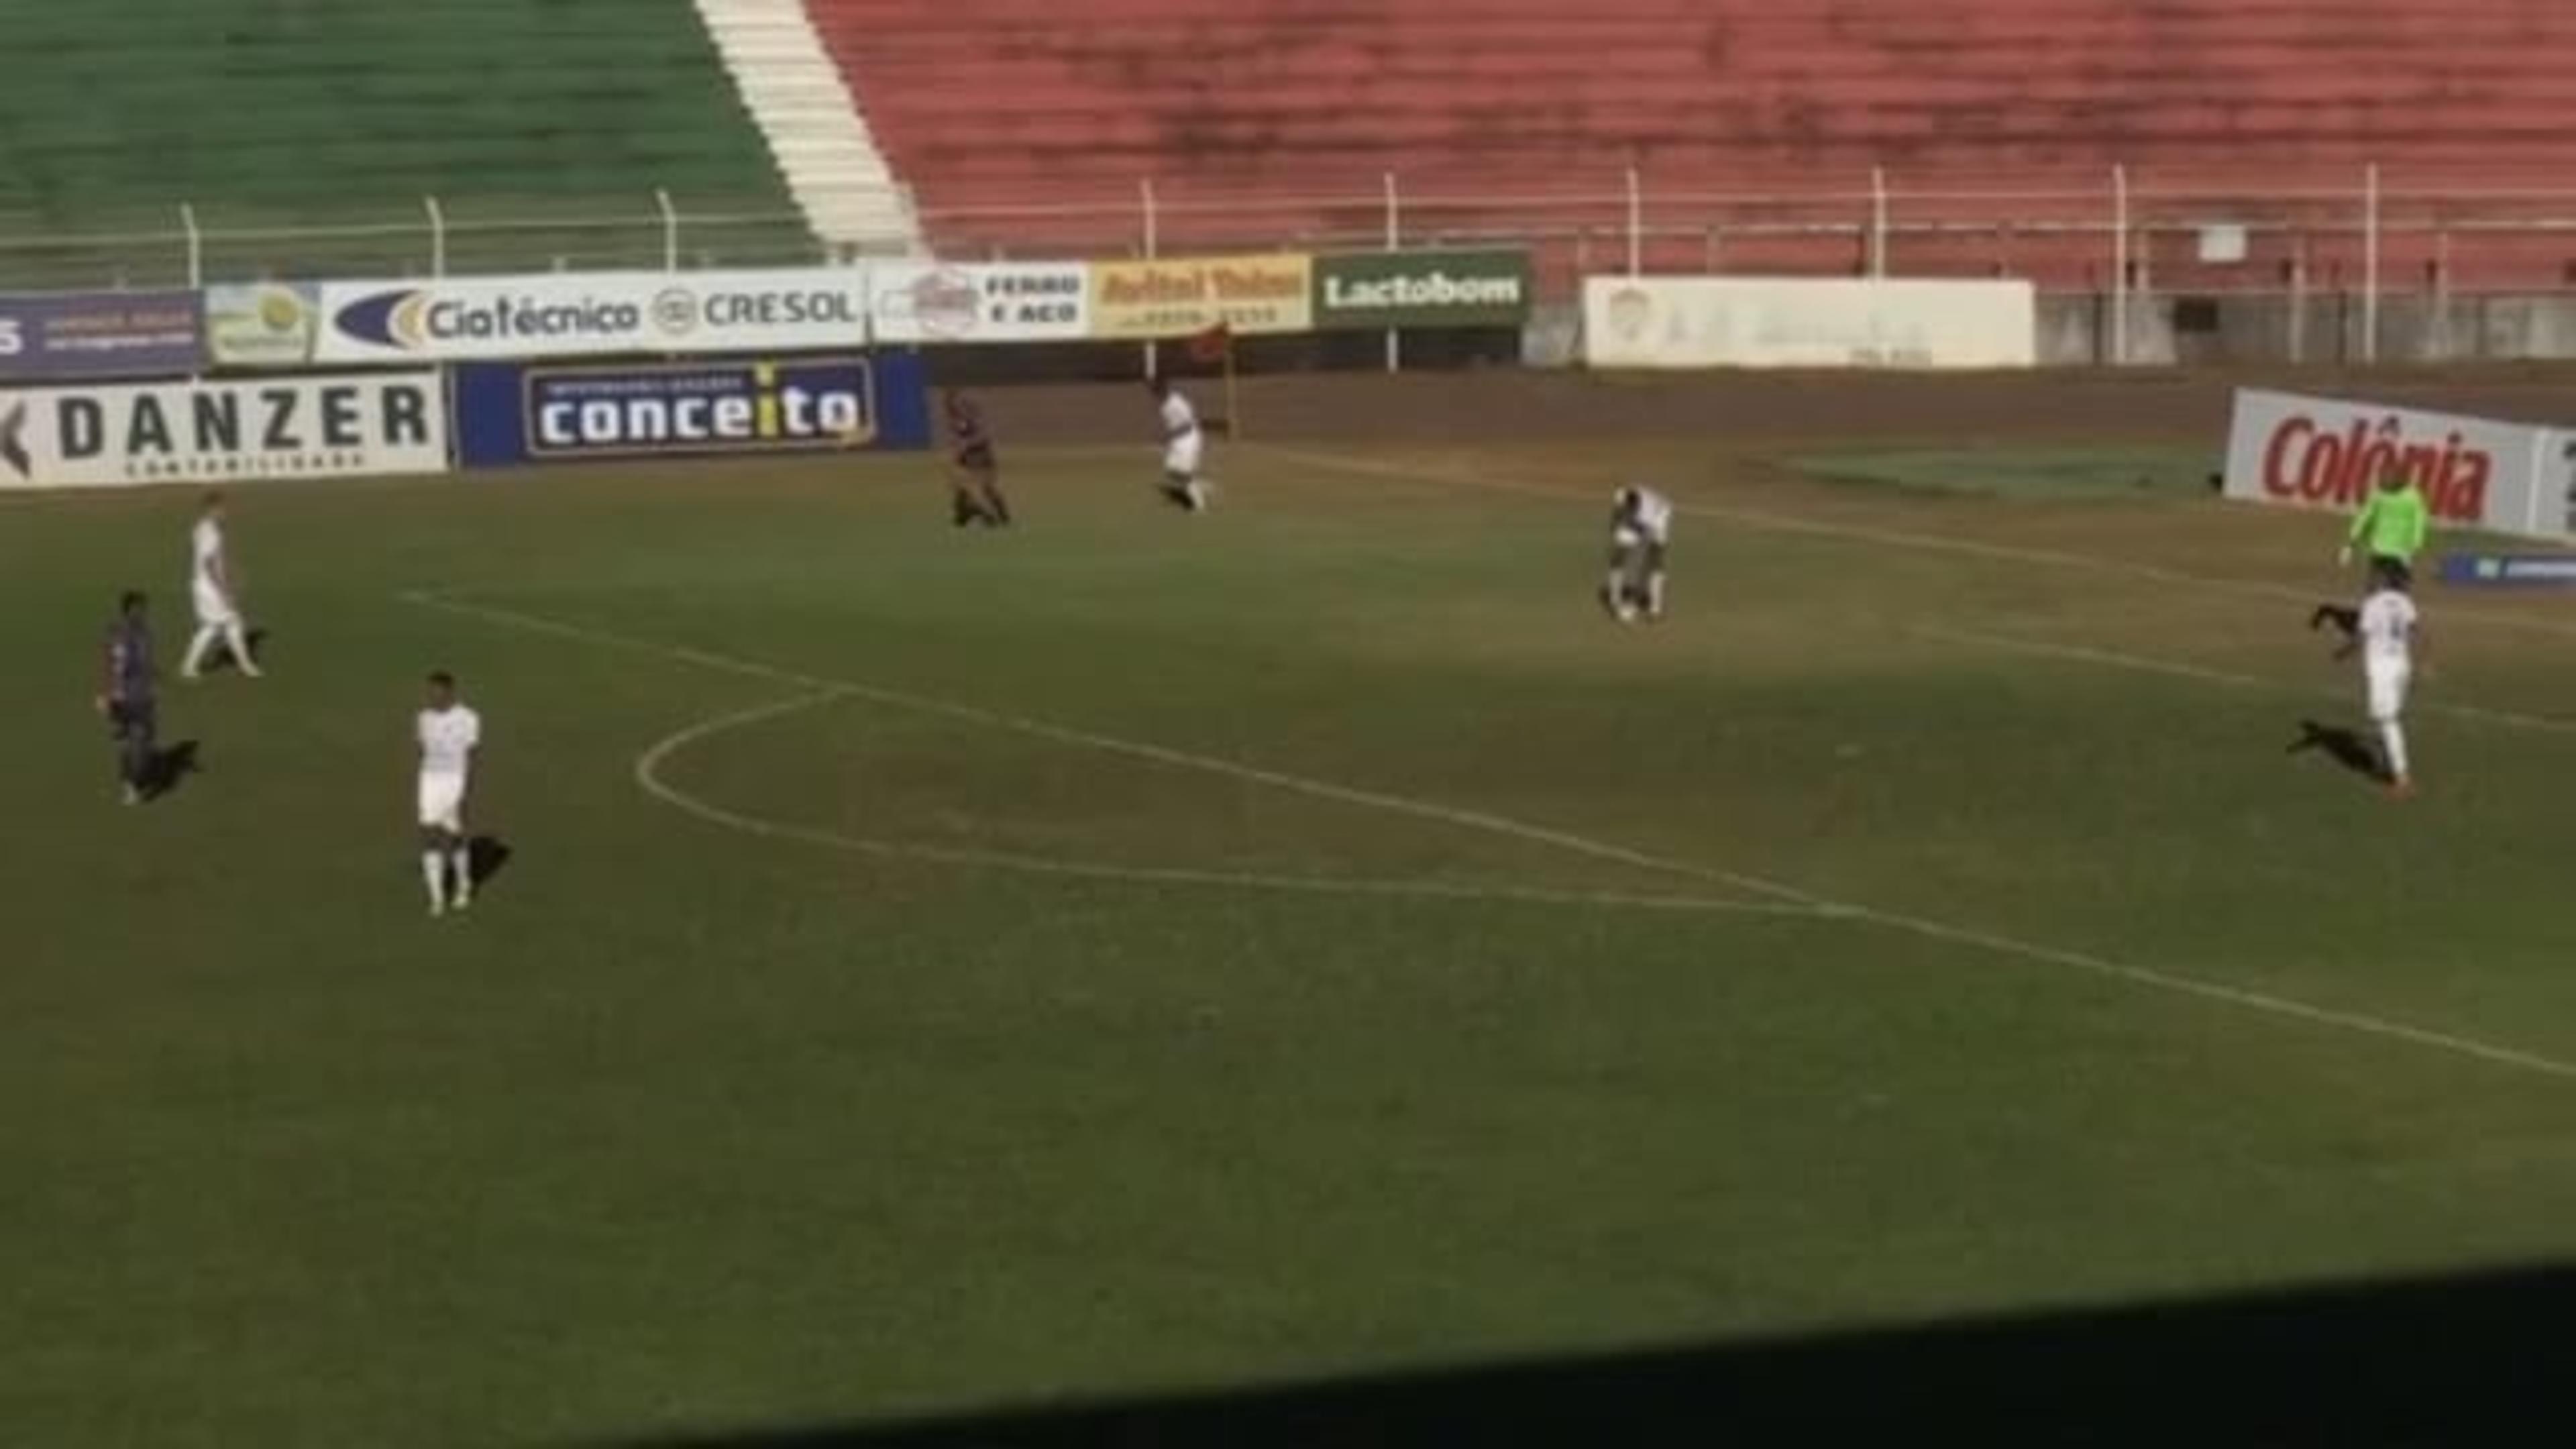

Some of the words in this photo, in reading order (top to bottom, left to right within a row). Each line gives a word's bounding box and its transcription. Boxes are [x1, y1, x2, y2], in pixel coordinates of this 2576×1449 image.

[427, 295, 639, 339] Ciatécnico
[704, 291, 857, 326] CRESOL
[1324, 272, 1520, 307] Lactobom
[58, 385, 428, 460] DANZER
[539, 359, 860, 444] conceito
[2263, 415, 2490, 521] Colônia
